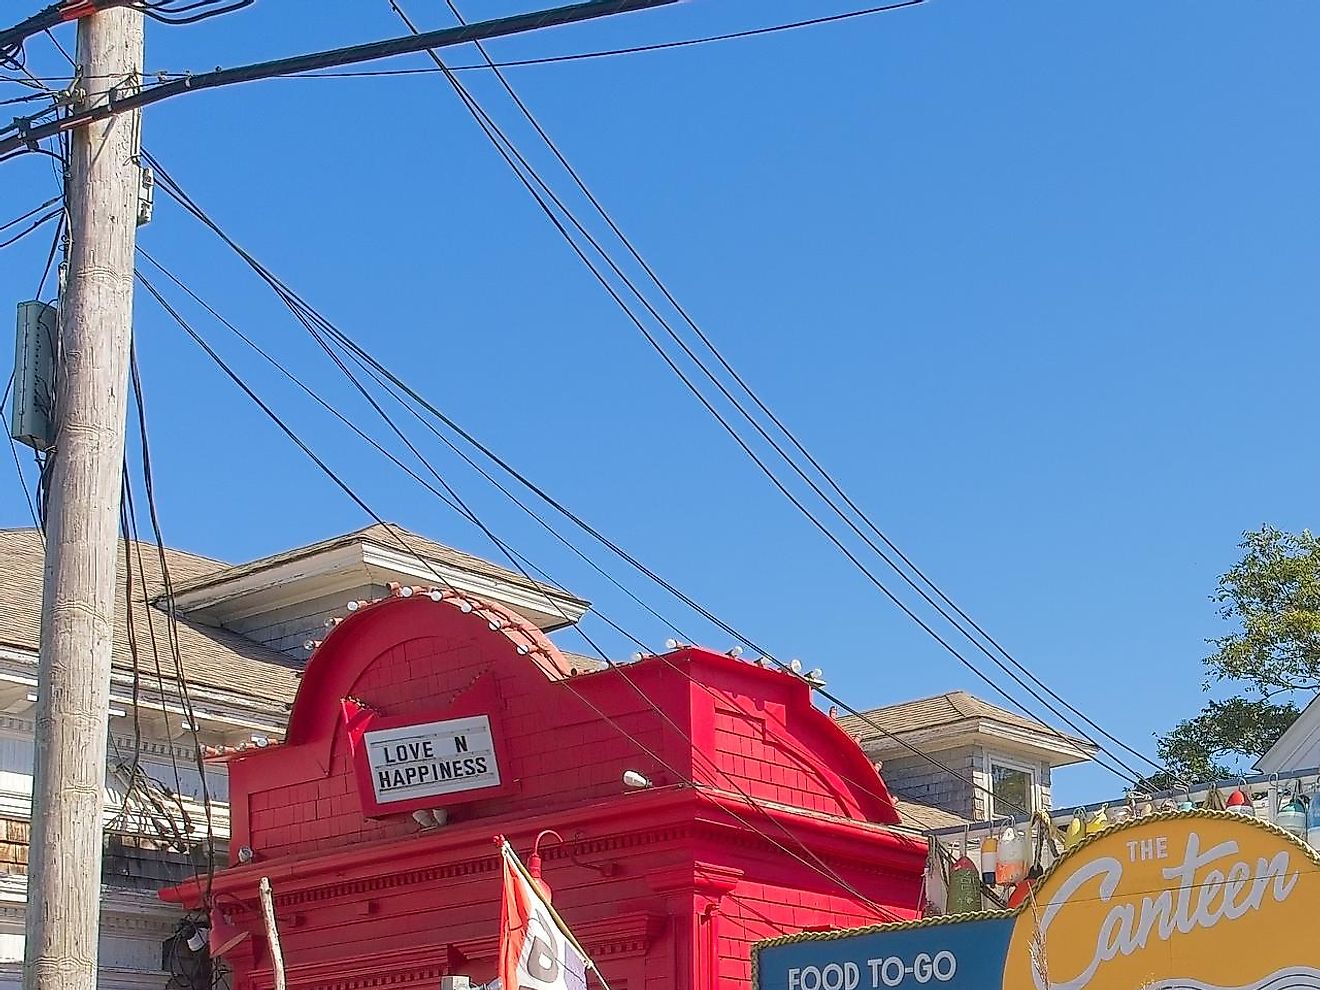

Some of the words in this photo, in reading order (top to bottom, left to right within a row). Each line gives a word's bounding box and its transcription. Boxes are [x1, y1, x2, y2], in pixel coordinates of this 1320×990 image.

[383, 741, 434, 764] LOVE
[454, 735, 468, 753] N
[378, 756, 488, 789] HAPPINESS
[1126, 836, 1169, 863] THE
[867, 950, 958, 988] TO-GO
